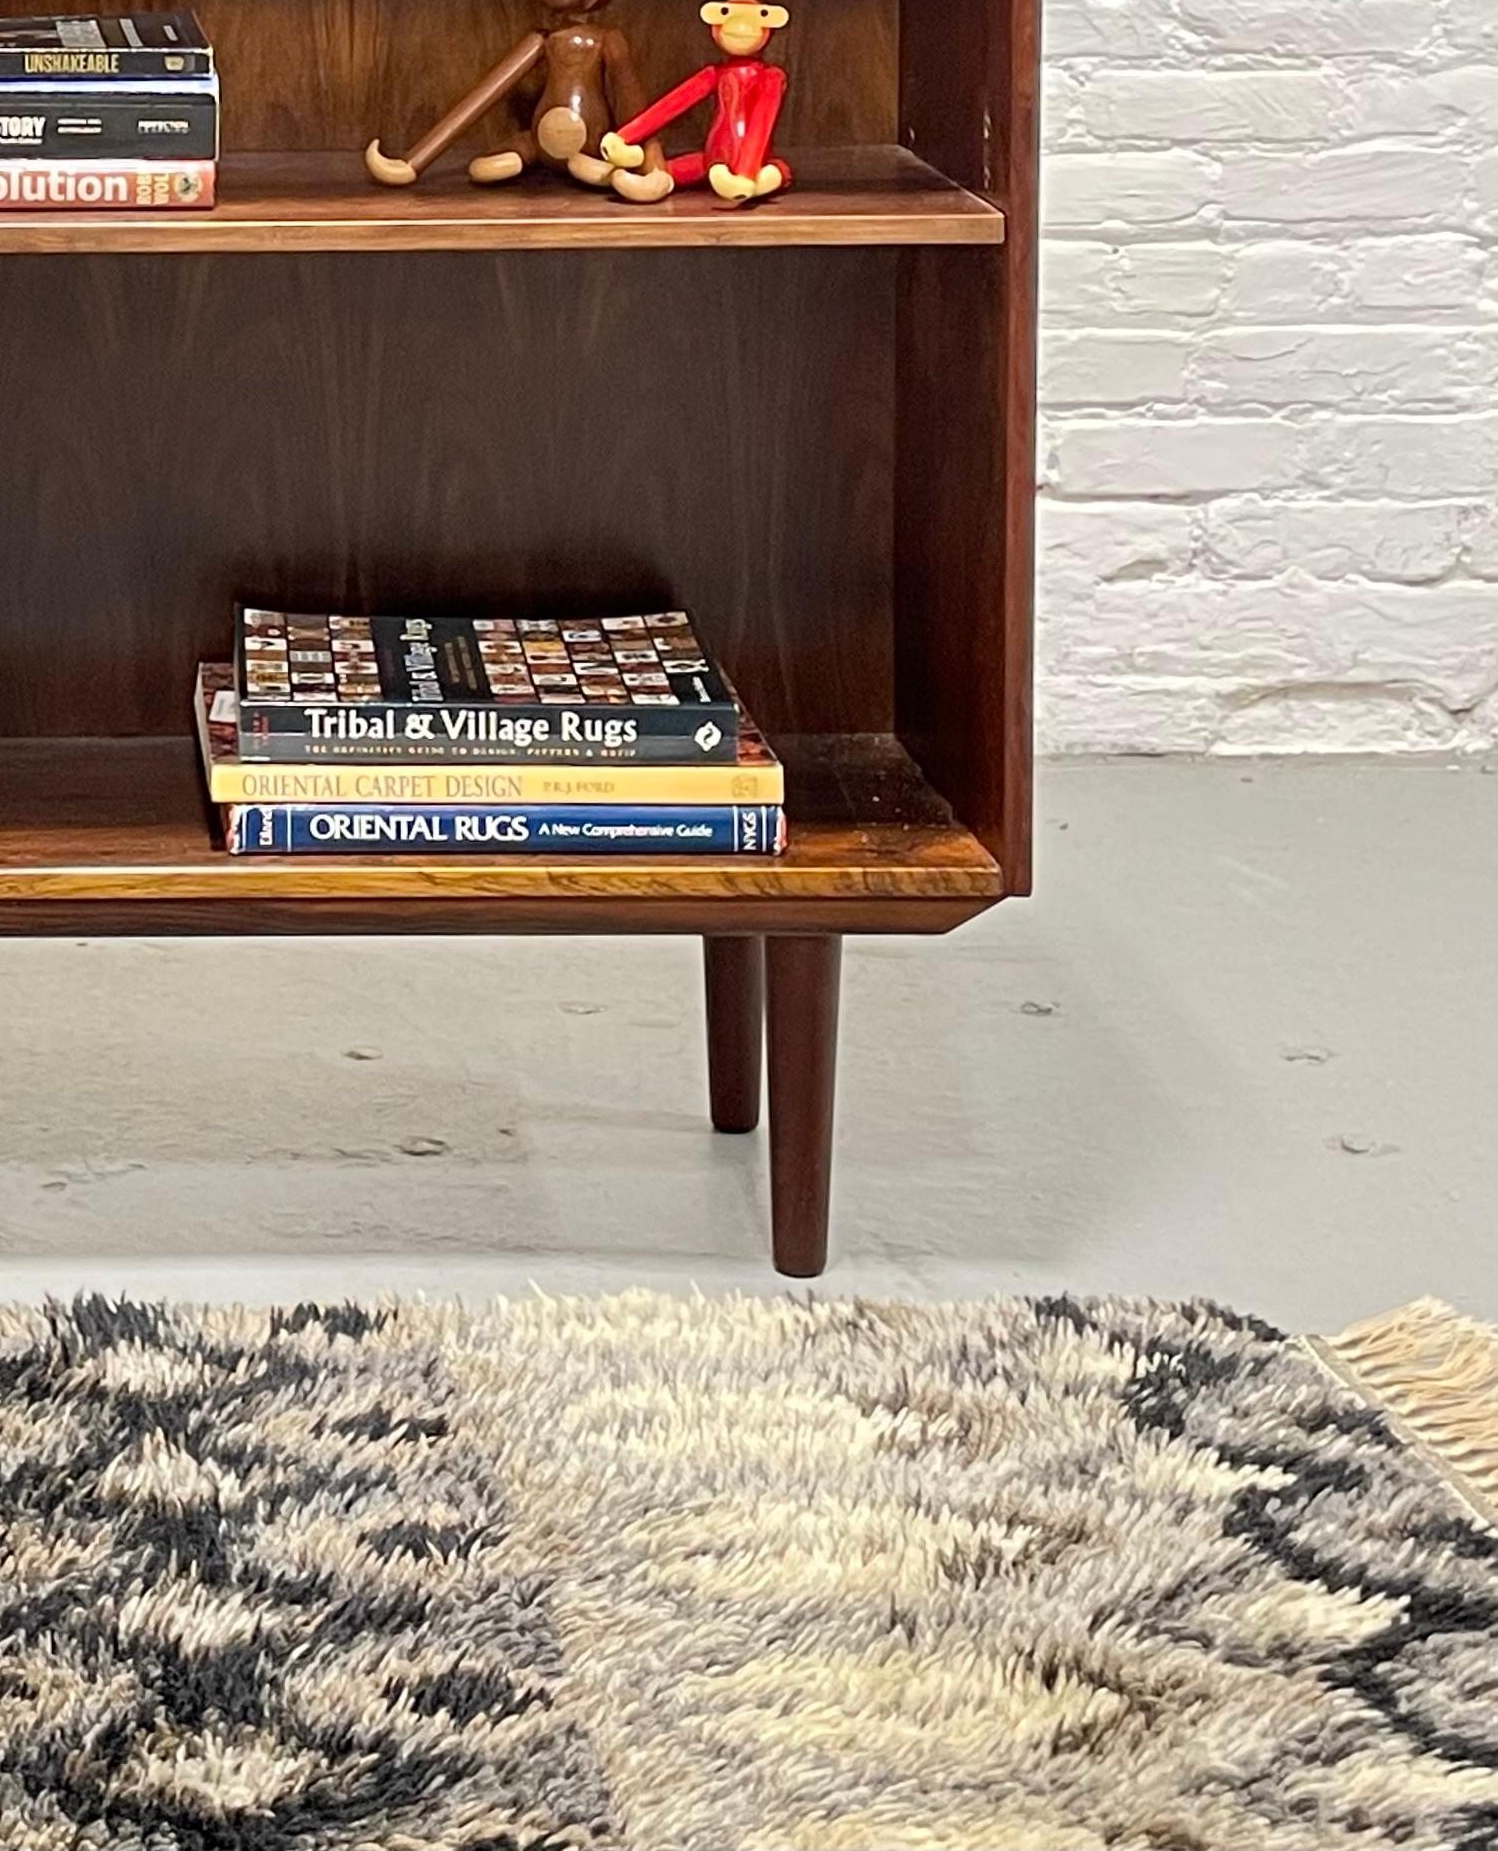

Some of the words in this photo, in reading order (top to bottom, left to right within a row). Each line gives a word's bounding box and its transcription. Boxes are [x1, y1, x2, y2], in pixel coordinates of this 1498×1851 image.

[24, 54, 120, 73] UNSHAKEABLE
[303, 708, 395, 739] Tribal
[405, 715, 436, 740] &
[439, 709, 550, 747] Village
[561, 711, 638, 749] Rugs
[242, 774, 348, 797] ORIENTAL
[355, 775, 436, 798] CARPET
[445, 775, 523, 798] DESIGN
[576, 781, 615, 794] FORD
[310, 815, 448, 841] ORIENTAL
[456, 816, 529, 841] RUGS
[538, 824, 551, 836] A
[552, 824, 580, 837] New
[582, 824, 674, 840] Comprehensive
[676, 824, 713, 838] Guide
